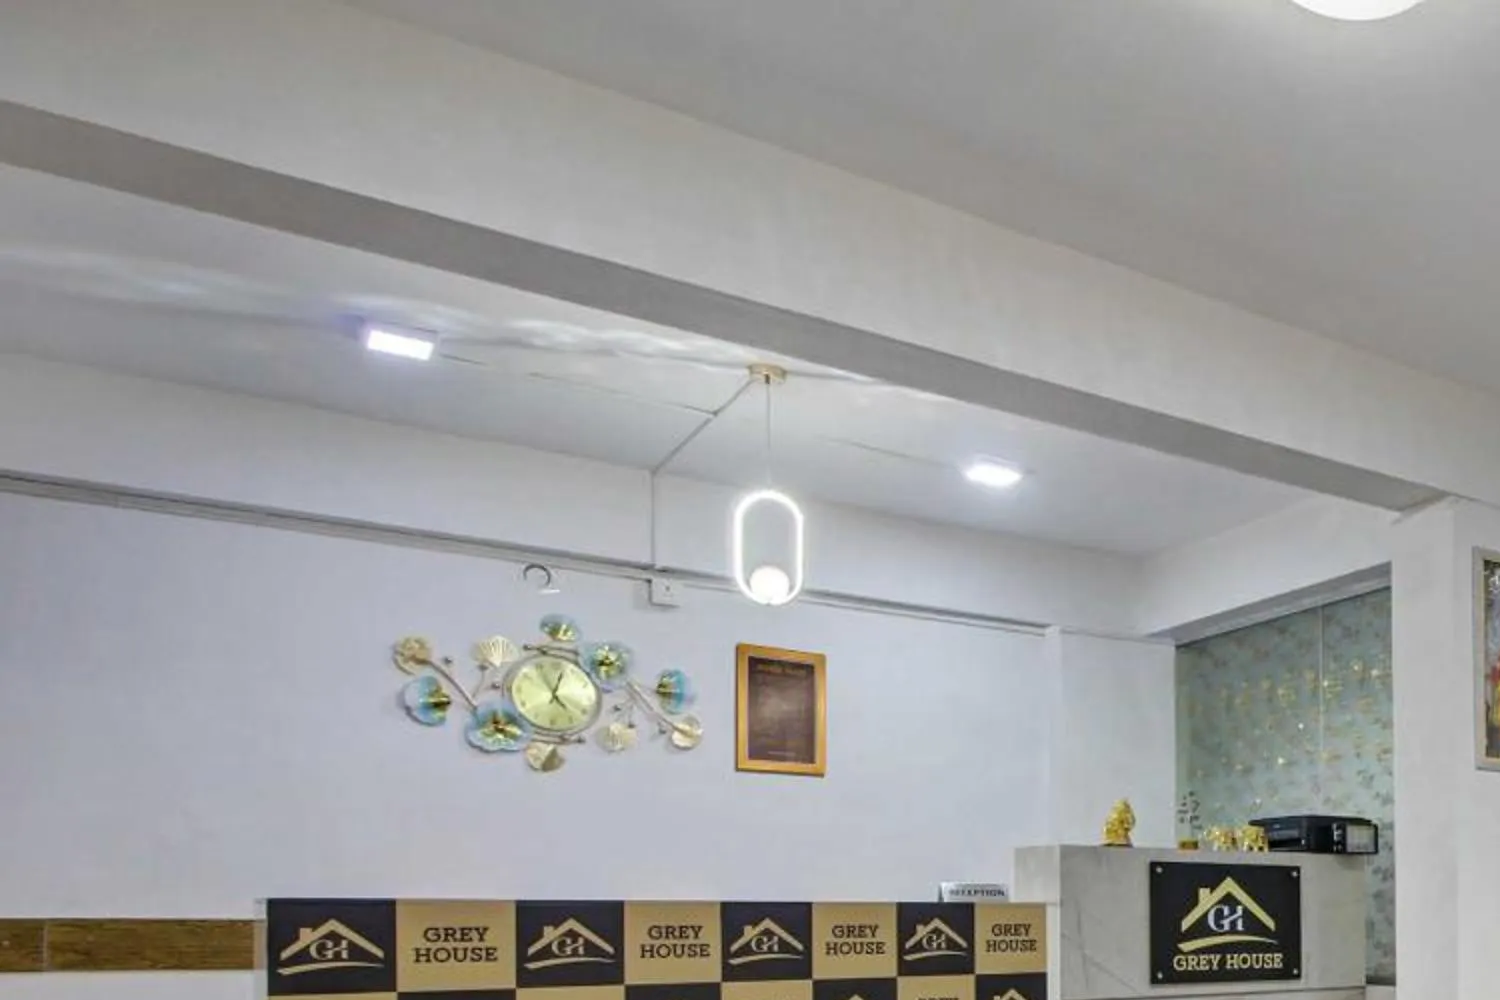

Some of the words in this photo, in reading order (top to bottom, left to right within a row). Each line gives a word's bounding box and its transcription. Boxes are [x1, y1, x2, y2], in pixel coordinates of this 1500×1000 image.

[424, 927, 489, 943] GREY
[648, 925, 704, 940] GREY
[831, 924, 879, 939] GREY
[991, 923, 1031, 937] GREY
[640, 943, 710, 959] HOUSE
[825, 941, 885, 956] HOUSE
[985, 938, 1037, 953] HOUSE
[414, 947, 498, 963] HOUSE
[1173, 954, 1221, 971] GREY
[1226, 953, 1283, 969] HOUSE
